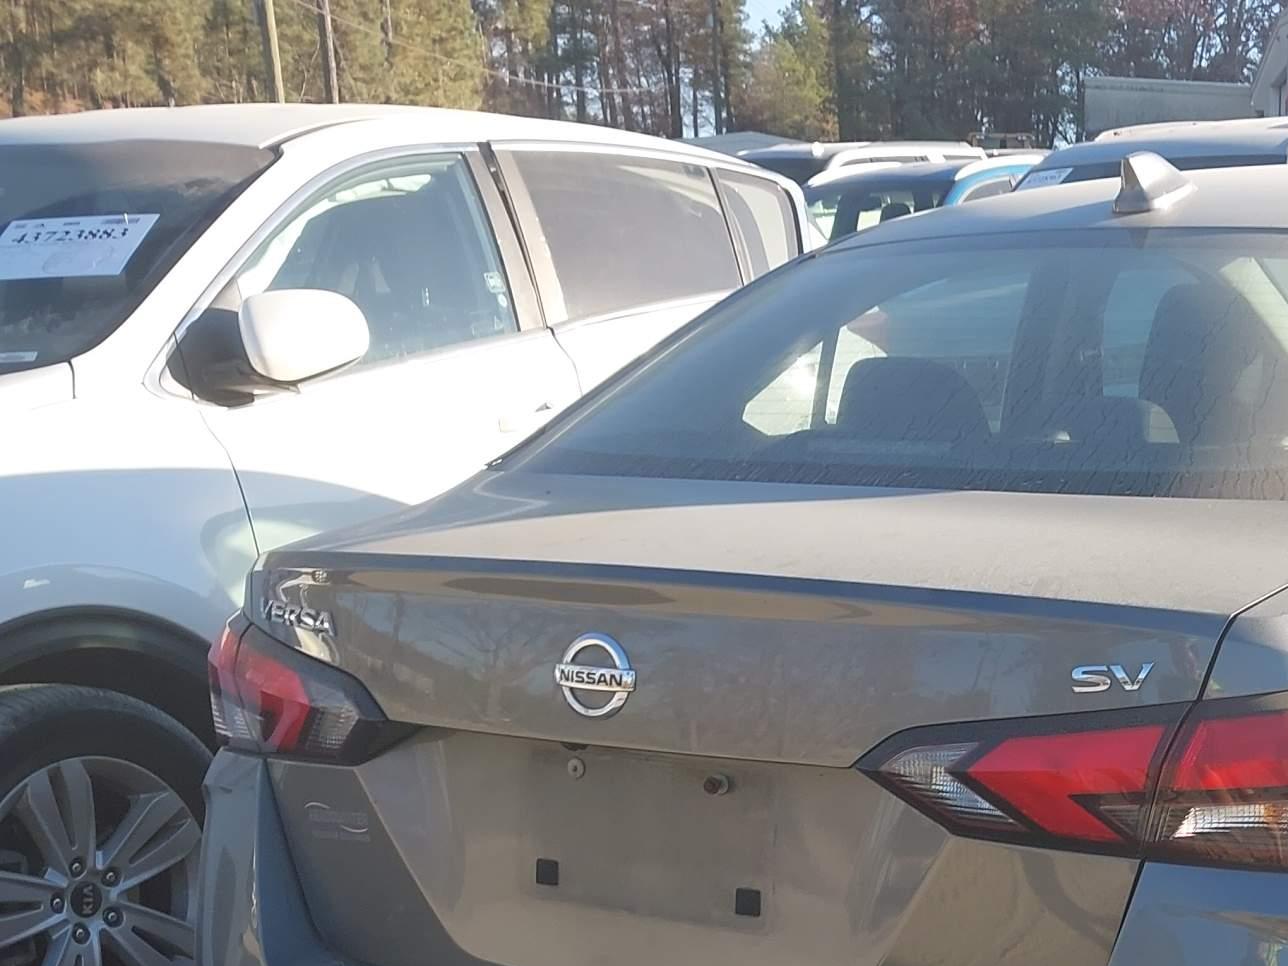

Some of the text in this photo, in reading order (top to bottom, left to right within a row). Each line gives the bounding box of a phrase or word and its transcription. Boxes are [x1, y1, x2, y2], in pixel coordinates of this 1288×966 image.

[11, 227, 129, 244] 43723883
[260, 597, 337, 637] VERSA
[560, 668, 623, 687] NISSAN
[1071, 662, 1155, 693] SV
[82, 884, 94, 914] KIA
